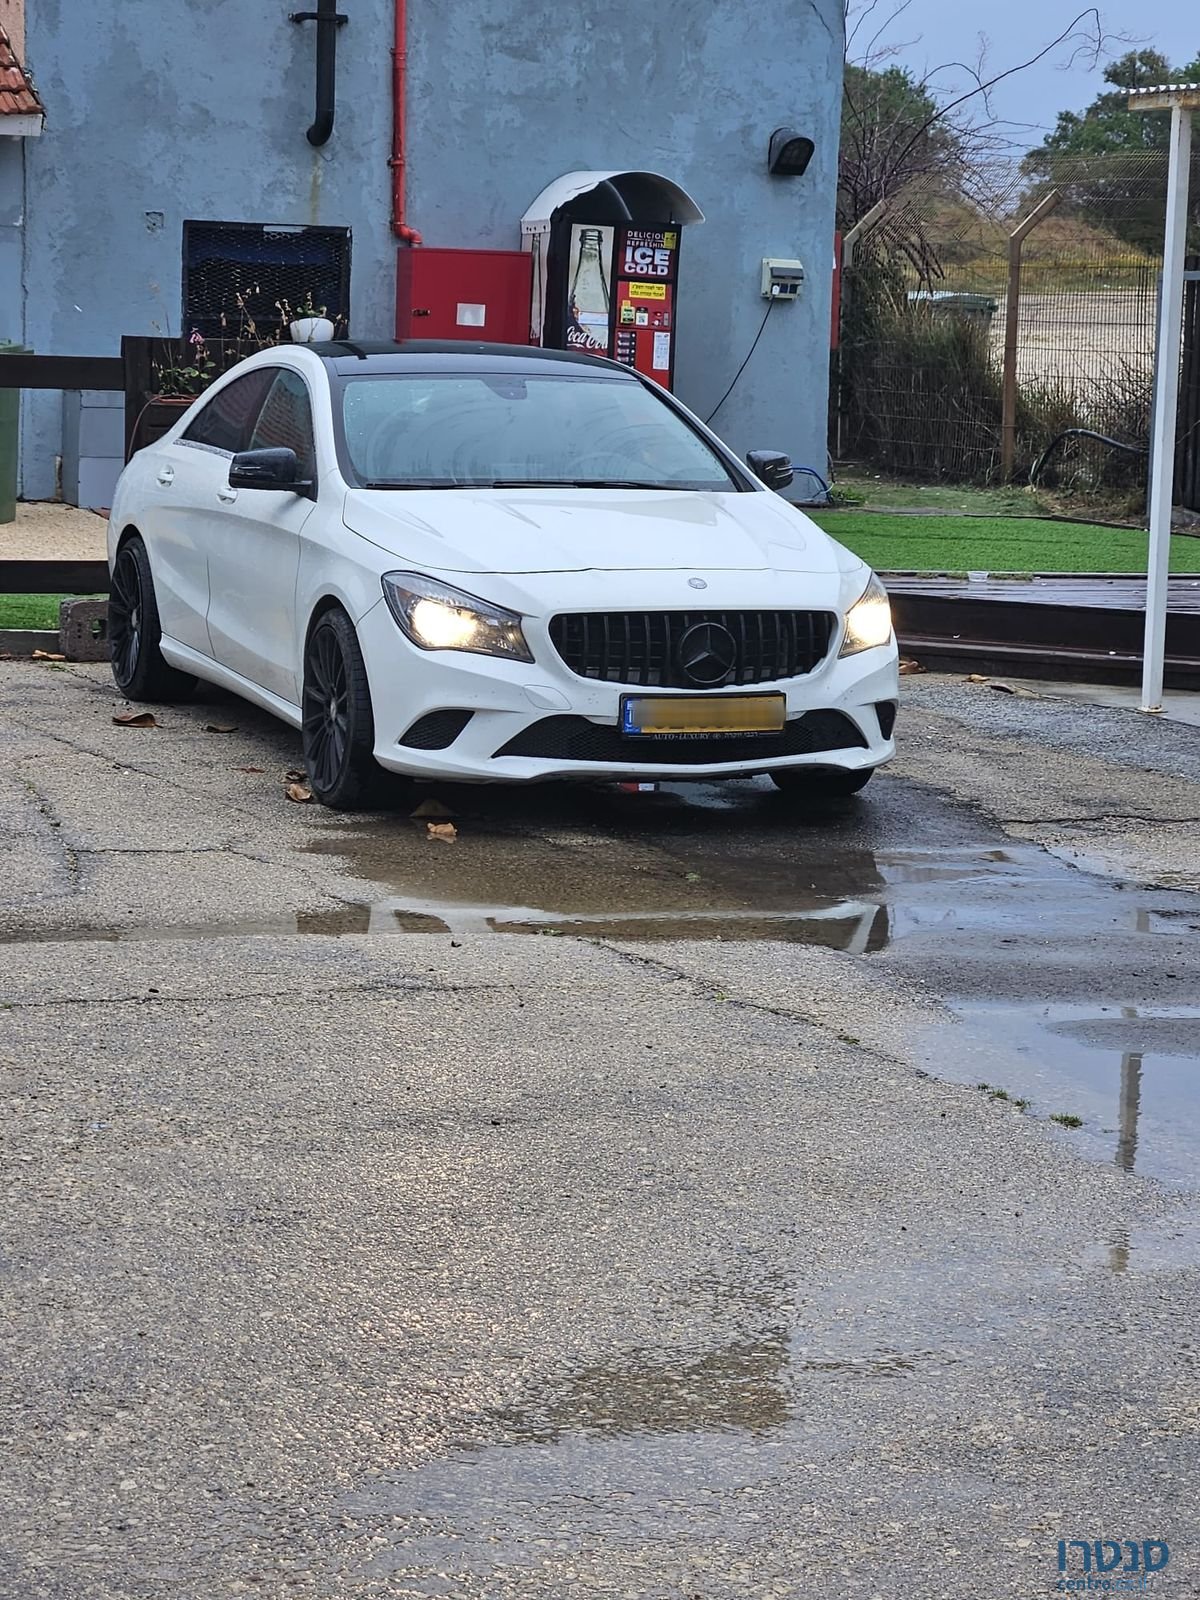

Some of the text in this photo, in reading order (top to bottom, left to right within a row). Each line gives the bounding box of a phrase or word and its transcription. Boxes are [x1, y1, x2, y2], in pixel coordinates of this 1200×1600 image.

[627, 230, 665, 240] DELICIO
[626, 240, 665, 249] REFRESHIN
[625, 246, 671, 266] ICE
[624, 262, 669, 276] COLD
